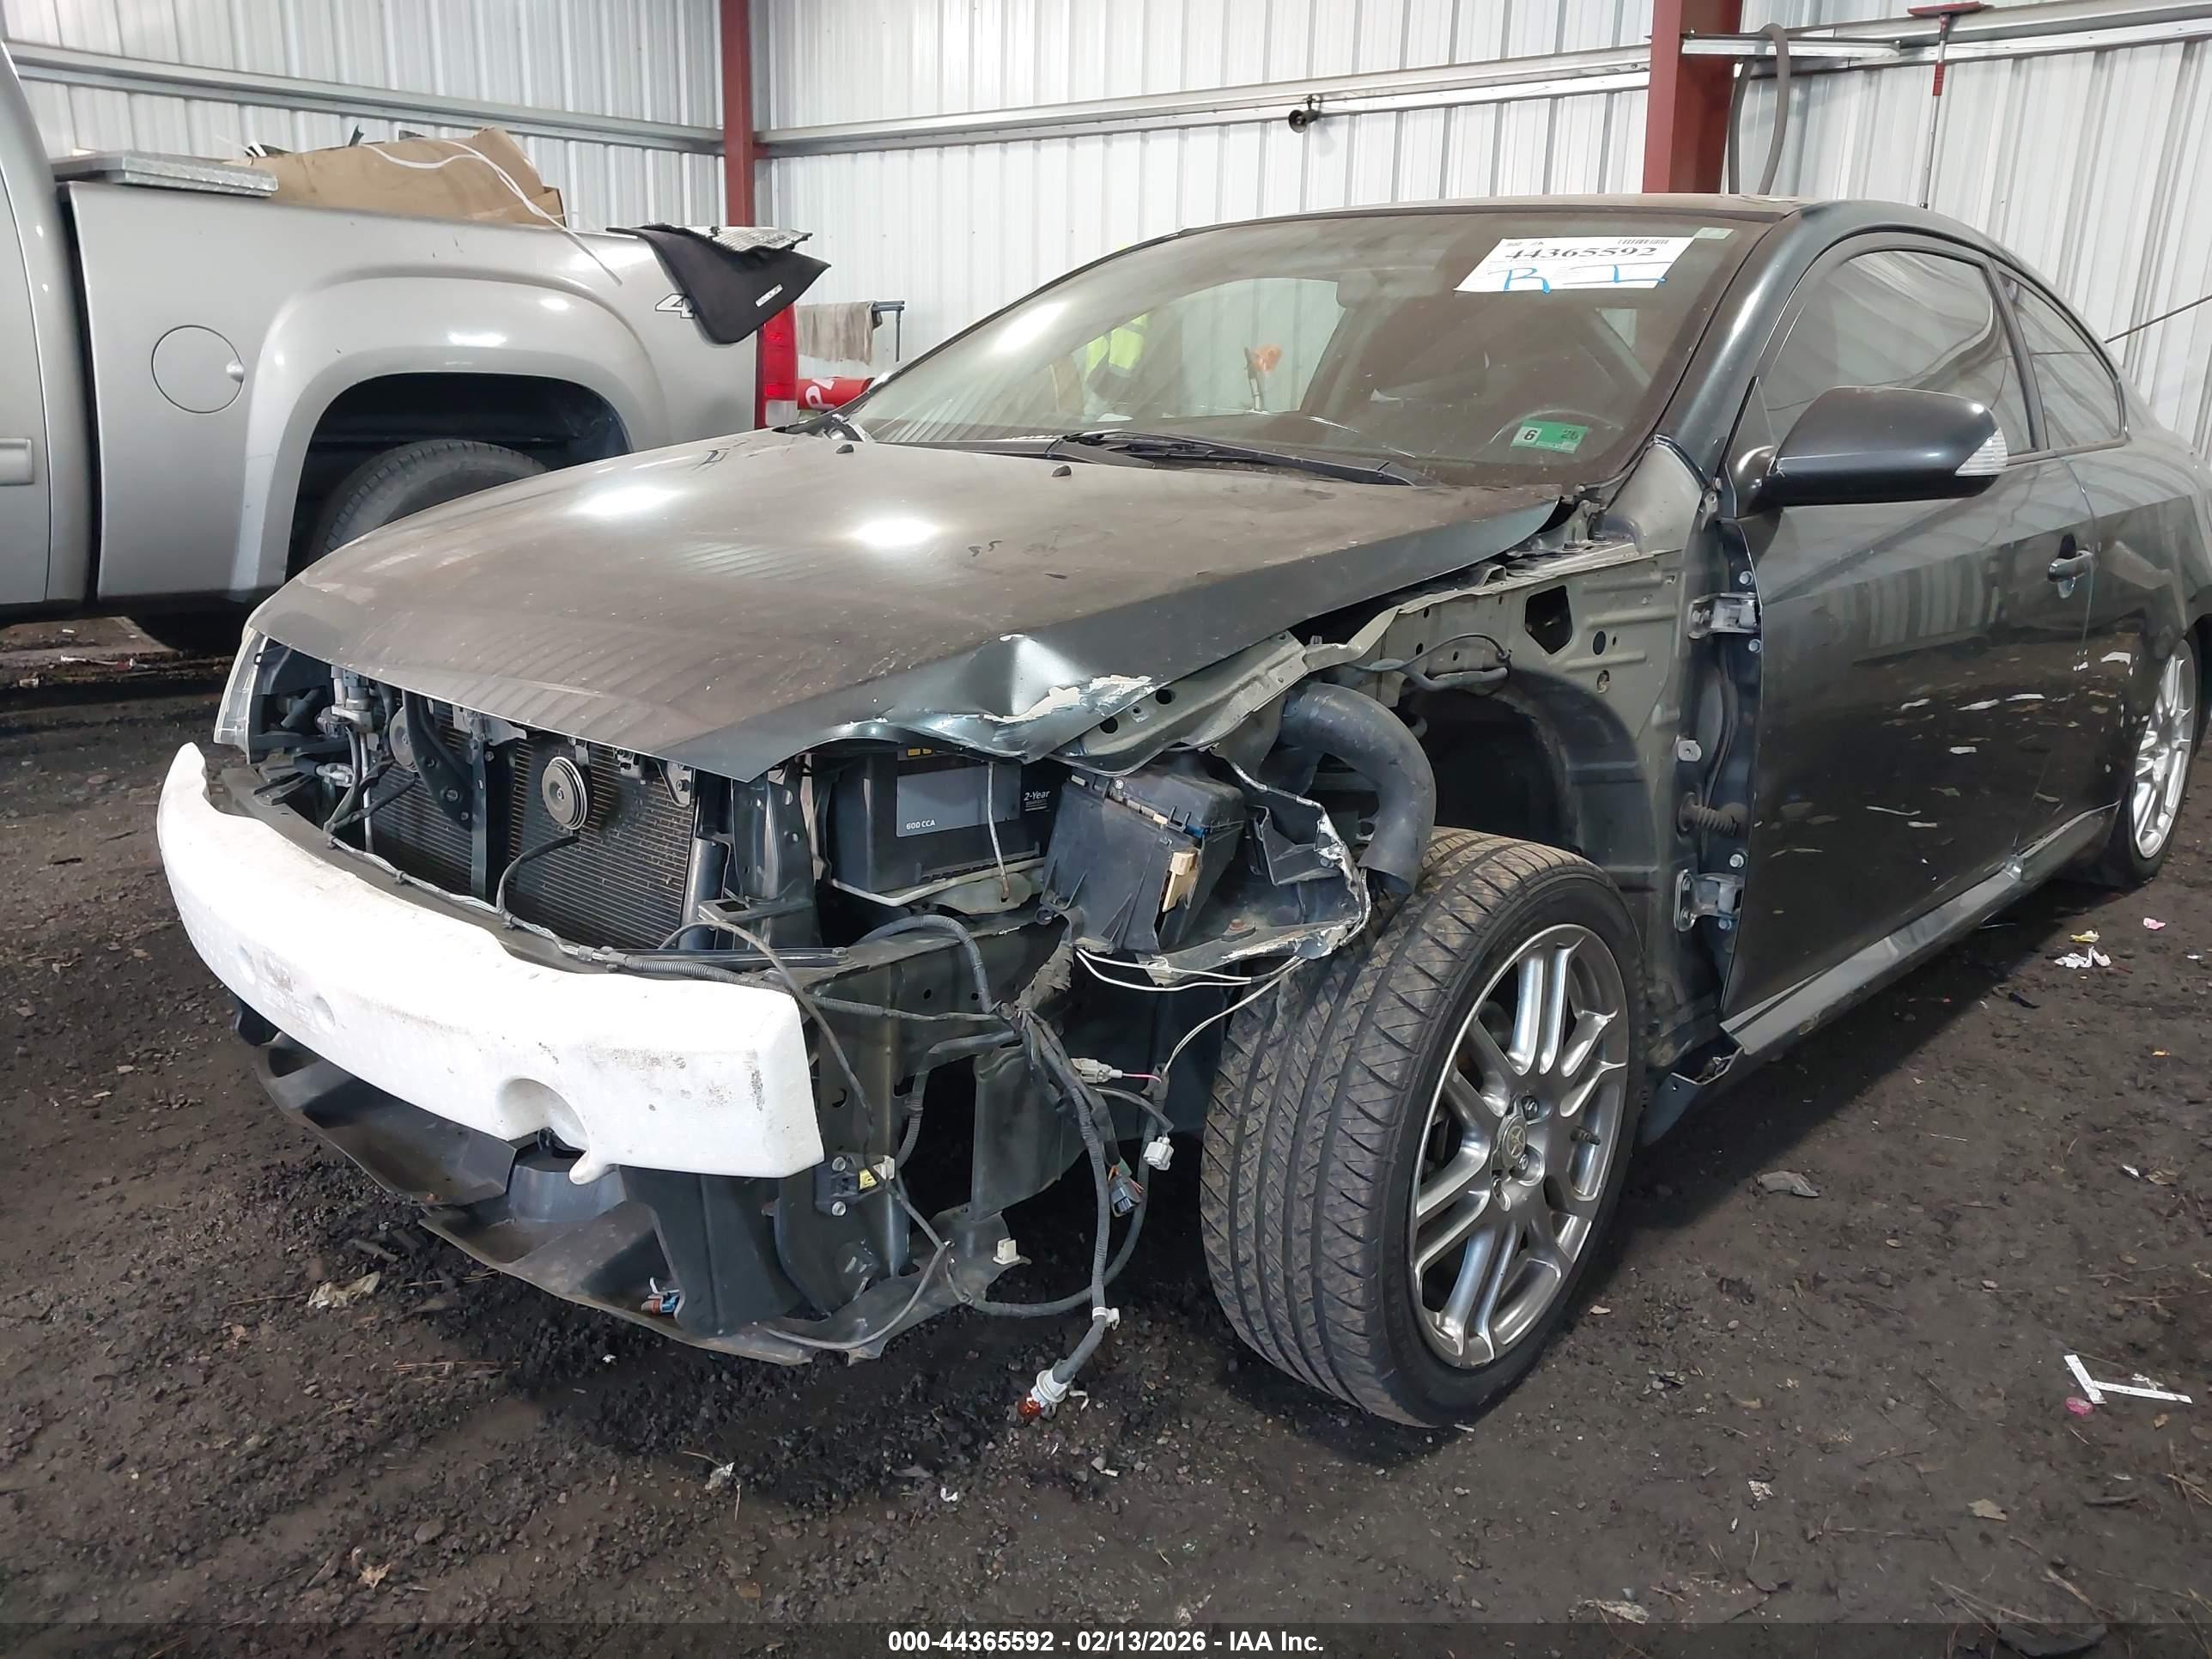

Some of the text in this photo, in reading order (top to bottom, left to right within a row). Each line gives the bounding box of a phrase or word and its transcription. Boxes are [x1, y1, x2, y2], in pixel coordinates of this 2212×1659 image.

[1505, 246, 1657, 260] 44365592
[1523, 429, 1538, 441] 6
[1024, 790, 1051, 801] 2-Year
[921, 819, 936, 828] CCA
